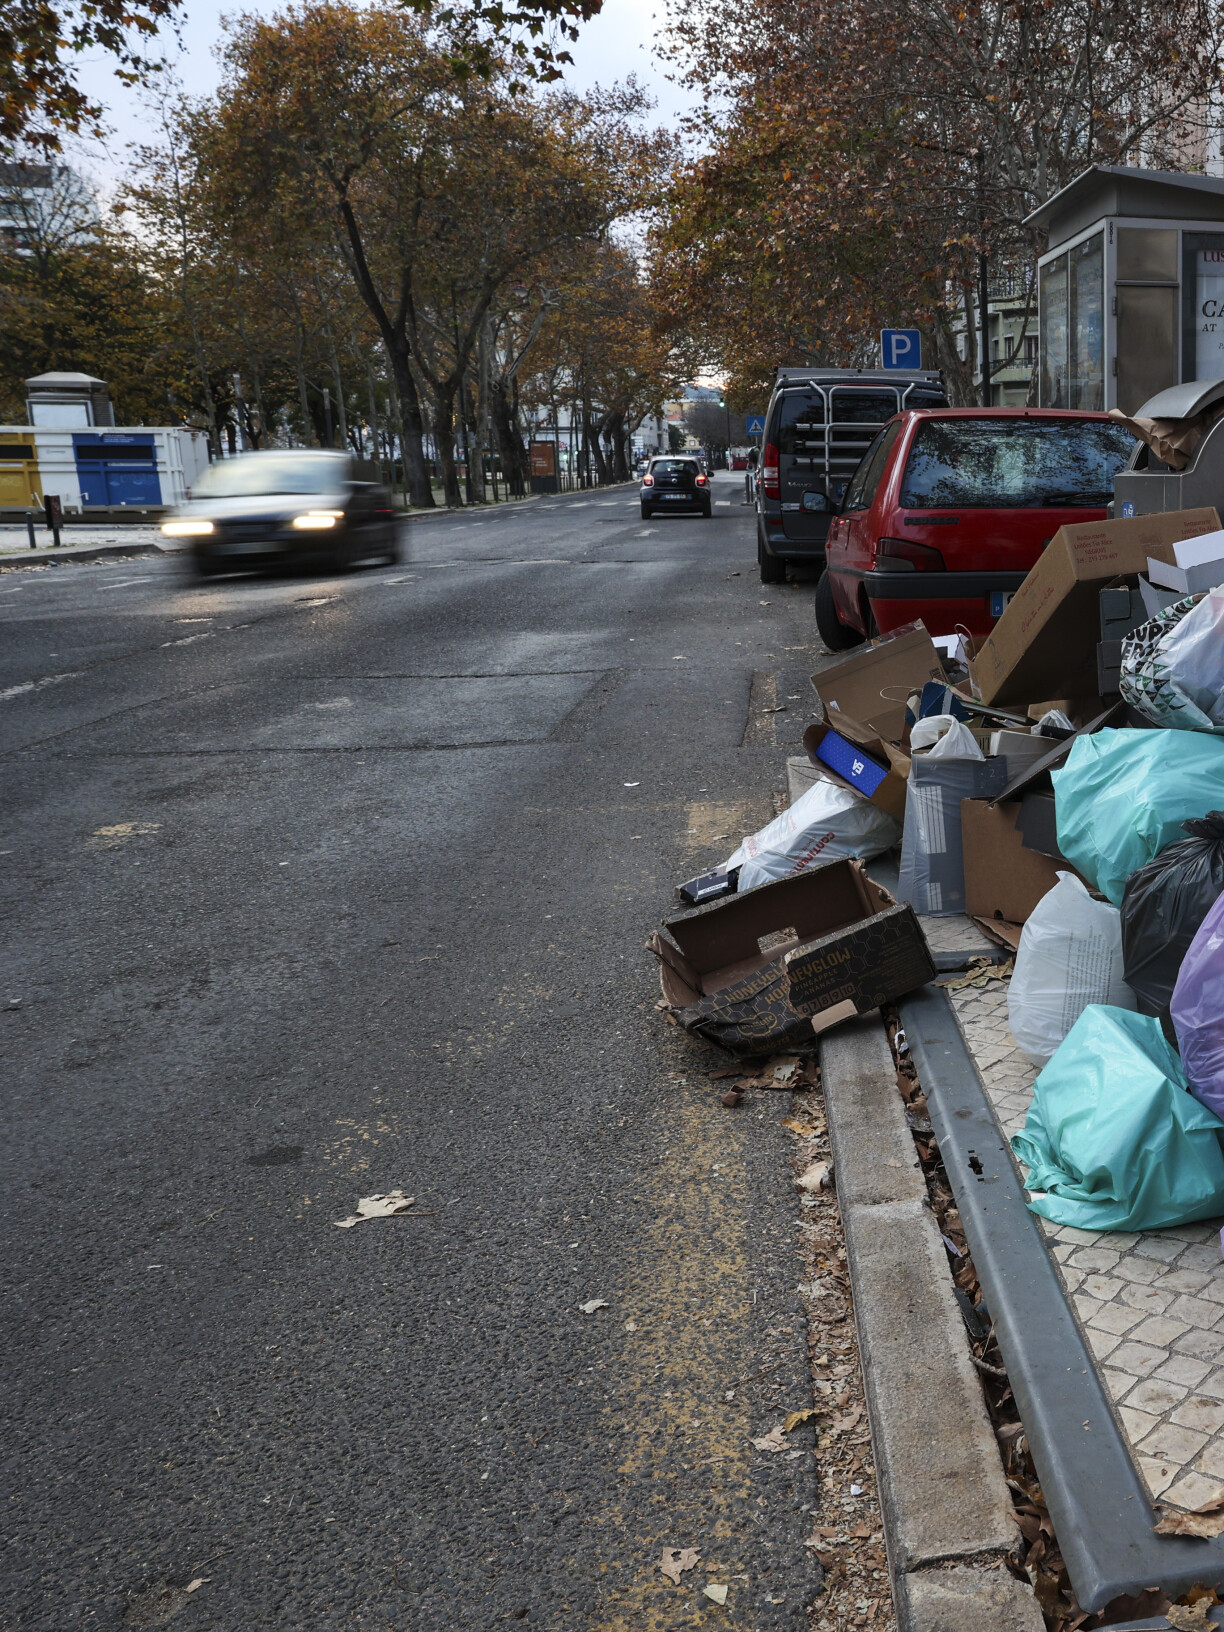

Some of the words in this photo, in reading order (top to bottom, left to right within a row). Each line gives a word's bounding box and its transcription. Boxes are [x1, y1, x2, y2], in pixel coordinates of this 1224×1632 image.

[1202, 323, 1218, 332] AT
[891, 334, 912, 365] P
[795, 968, 839, 992] PINEAPPLE
[801, 1004, 809, 1014] 6
[811, 1001, 818, 1010] 7
[821, 997, 829, 1006] 8
[832, 992, 840, 1001] 9
[843, 986, 856, 997] 10
